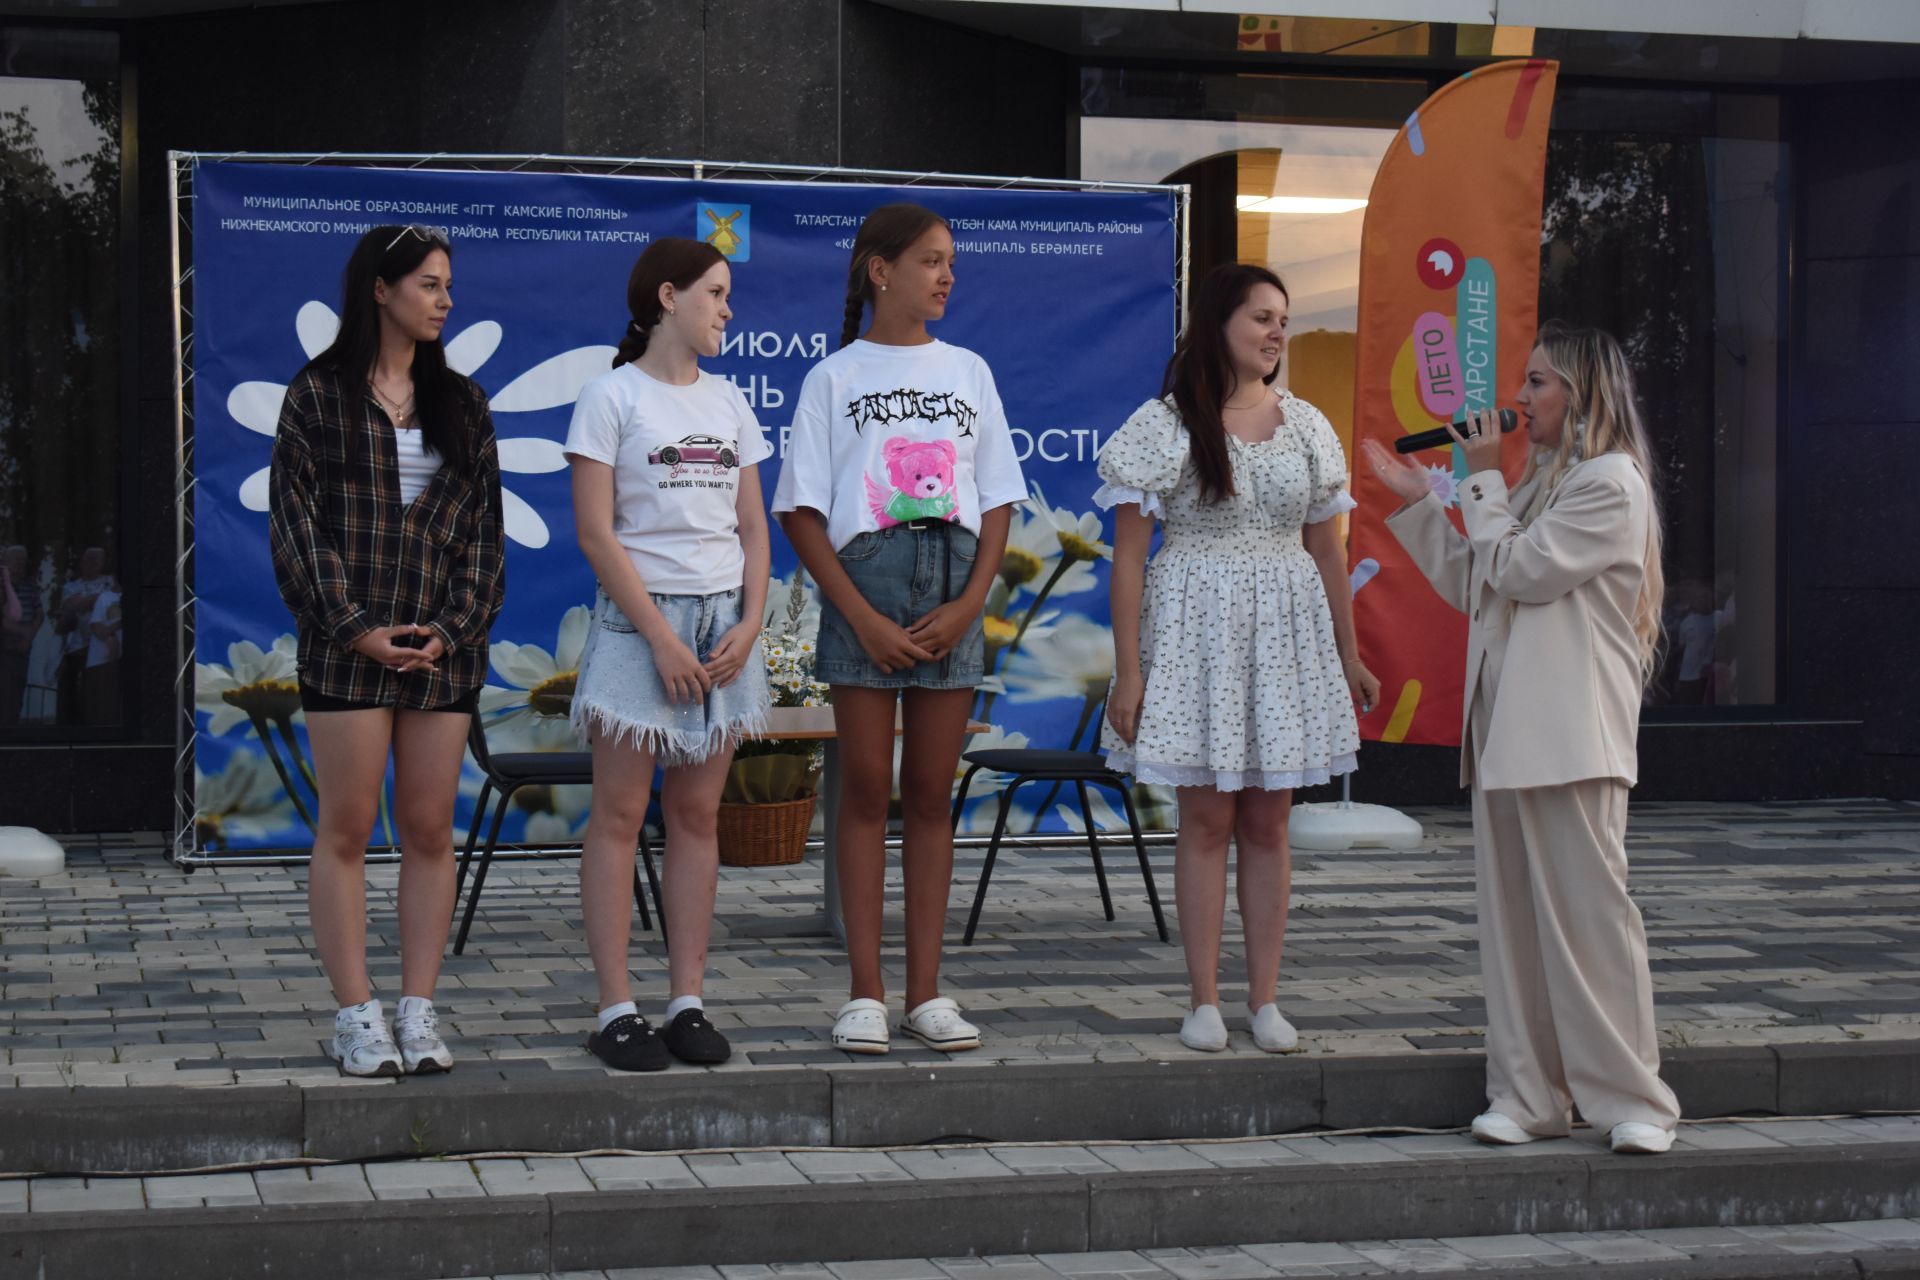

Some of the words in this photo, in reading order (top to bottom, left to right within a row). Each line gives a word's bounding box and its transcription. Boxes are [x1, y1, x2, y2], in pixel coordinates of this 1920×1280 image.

[243, 196, 361, 211] МУНИЦИПАЛЬНОЕ
[366, 200, 459, 215] ОБРАЗОВАНИЕ
[463, 204, 496, 216] «ПГТ
[503, 205, 563, 219] КАМСКИЕ
[567, 207, 629, 221] ПОЛЯНЫ»
[221, 218, 331, 233] НИЖНЕКАМСКОГО
[794, 214, 857, 227] ТАТАРСТАН
[988, 219, 1018, 231] КАМА
[1020, 220, 1095, 234] МУНИЦИПАЛЬ
[1097, 220, 1143, 234] РАЙОНЫ
[451, 224, 499, 239] РАЙОНА
[505, 228, 581, 242] РЕСПУБЛИКИ
[583, 230, 650, 243] ТАТАРСТАН
[952, 241, 1026, 254] НИЦИПАЛЬ
[1031, 242, 1103, 255] БЕРӘМЛЕГЕ
[721, 331, 827, 358] ИЮЛЯ
[1464, 279, 1489, 421] ТАРСТАНЕ
[1423, 328, 1455, 396] ЛЕТО
[658, 481, 668, 489] GO
[669, 479, 693, 488] WHERE
[694, 479, 707, 488] YOU
[707, 480, 724, 489] WANT
